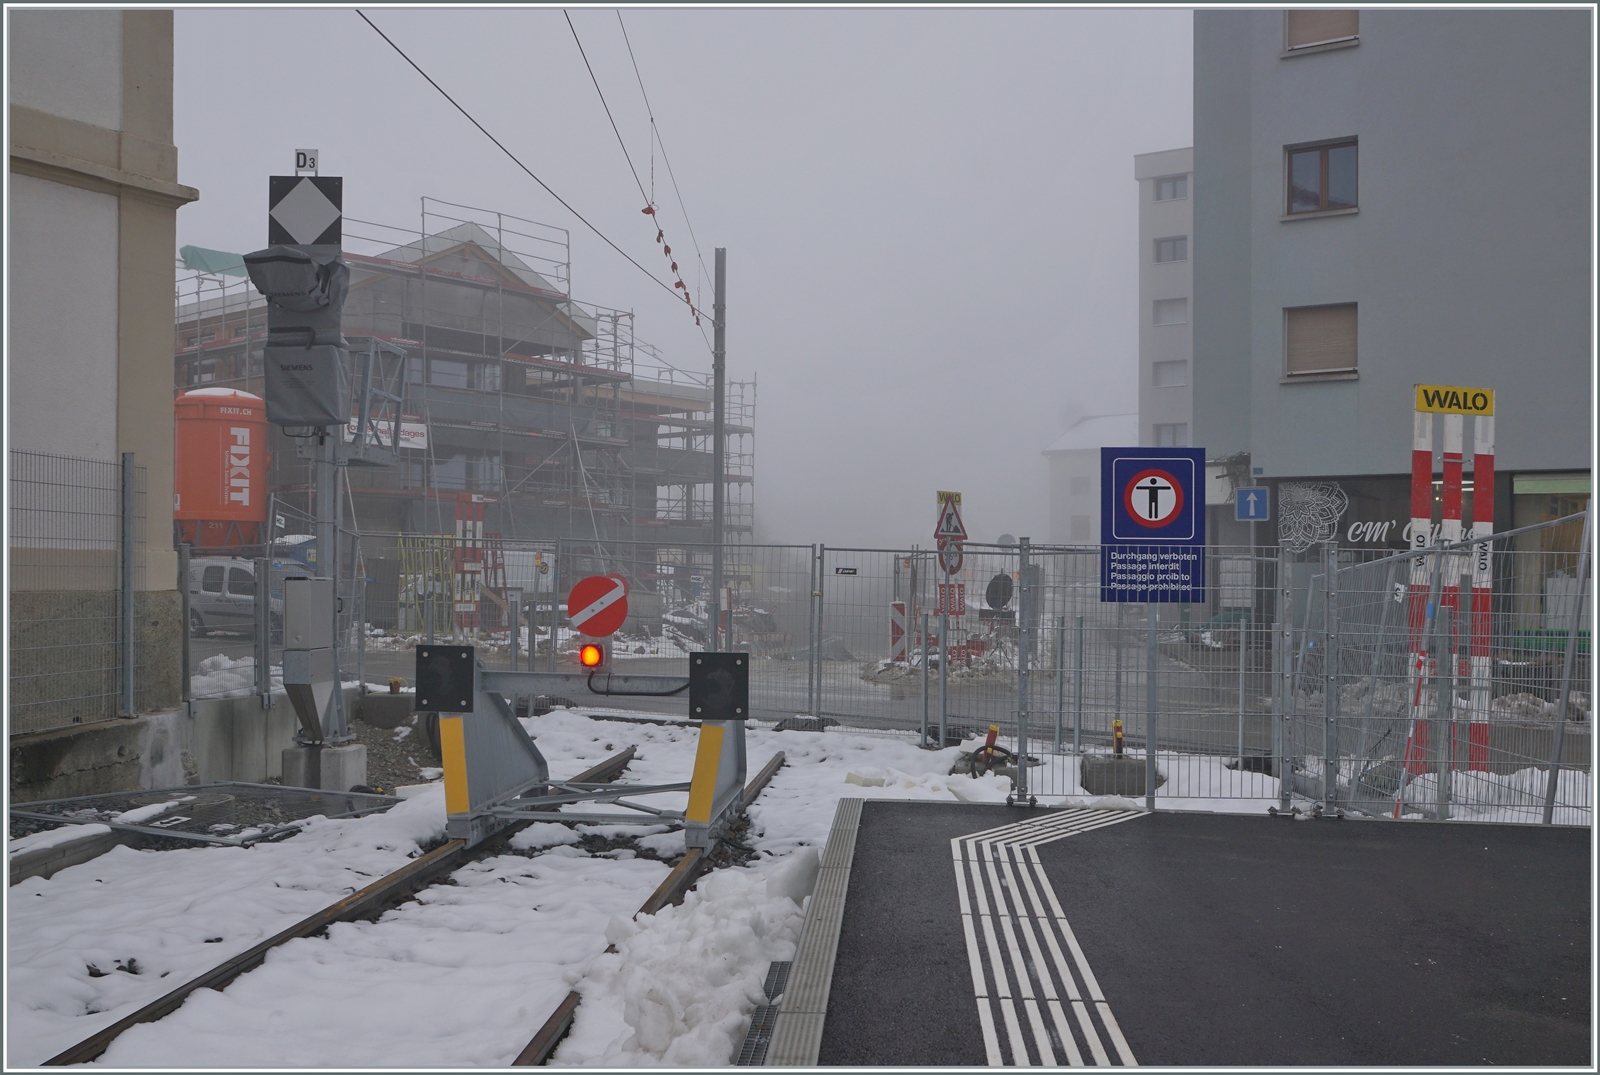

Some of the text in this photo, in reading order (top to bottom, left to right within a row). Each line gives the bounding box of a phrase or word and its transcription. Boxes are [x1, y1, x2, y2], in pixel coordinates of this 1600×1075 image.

[1422, 389, 1489, 411] WALO
[220, 406, 252, 416] FIXIT.CH
[230, 426, 250, 507] FIXIT
[939, 492, 961, 503] WLO
[208, 521, 223, 529] 211
[1415, 534, 1426, 568] WLO
[1478, 540, 1488, 571] WALO
[1110, 552, 1197, 561] Durchgang verboten
[1110, 562, 1179, 571] Passage interdit
[1110, 572, 1190, 581] Passaggio proibto
[1110, 582, 1192, 592] Passage prohbited
